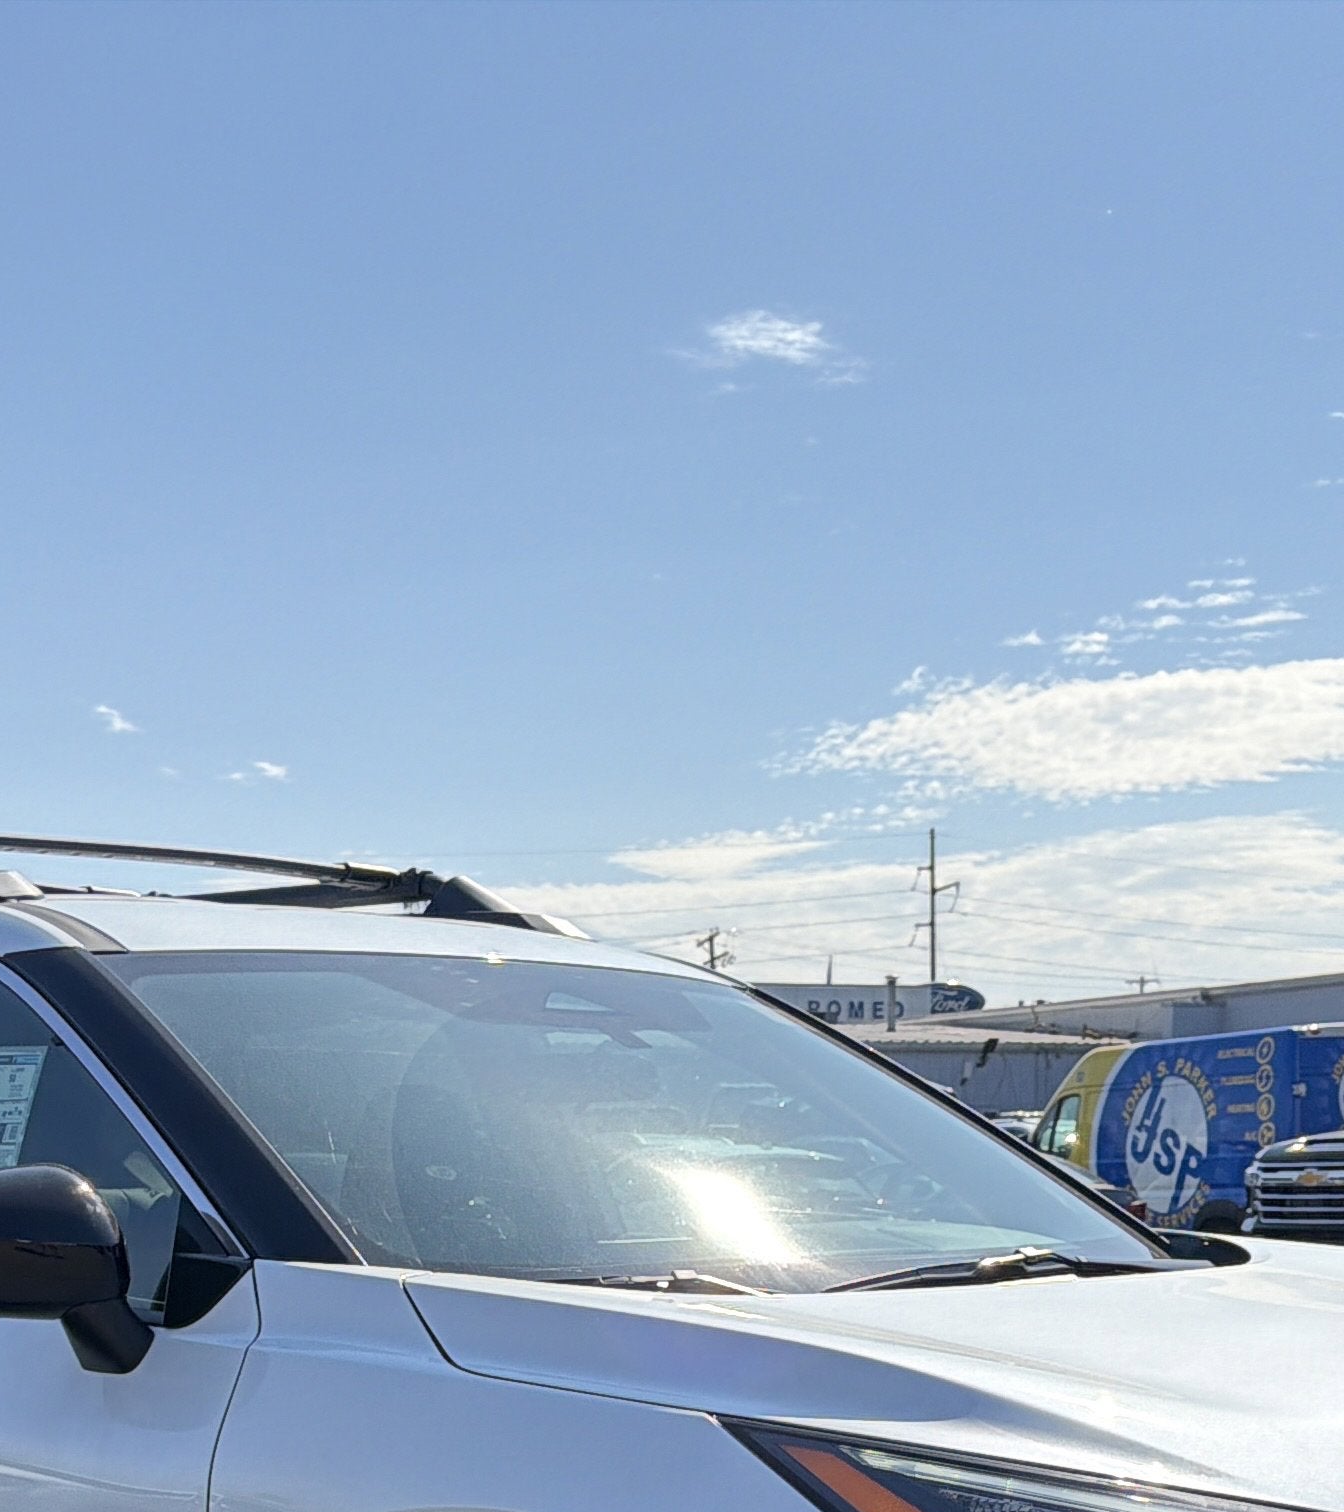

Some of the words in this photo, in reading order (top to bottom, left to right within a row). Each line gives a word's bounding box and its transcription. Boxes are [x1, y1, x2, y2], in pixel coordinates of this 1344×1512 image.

[932, 990, 970, 1013] Ford
[1122, 1071, 1152, 1126] JOHN
[1175, 1058, 1217, 1120] PARKER
